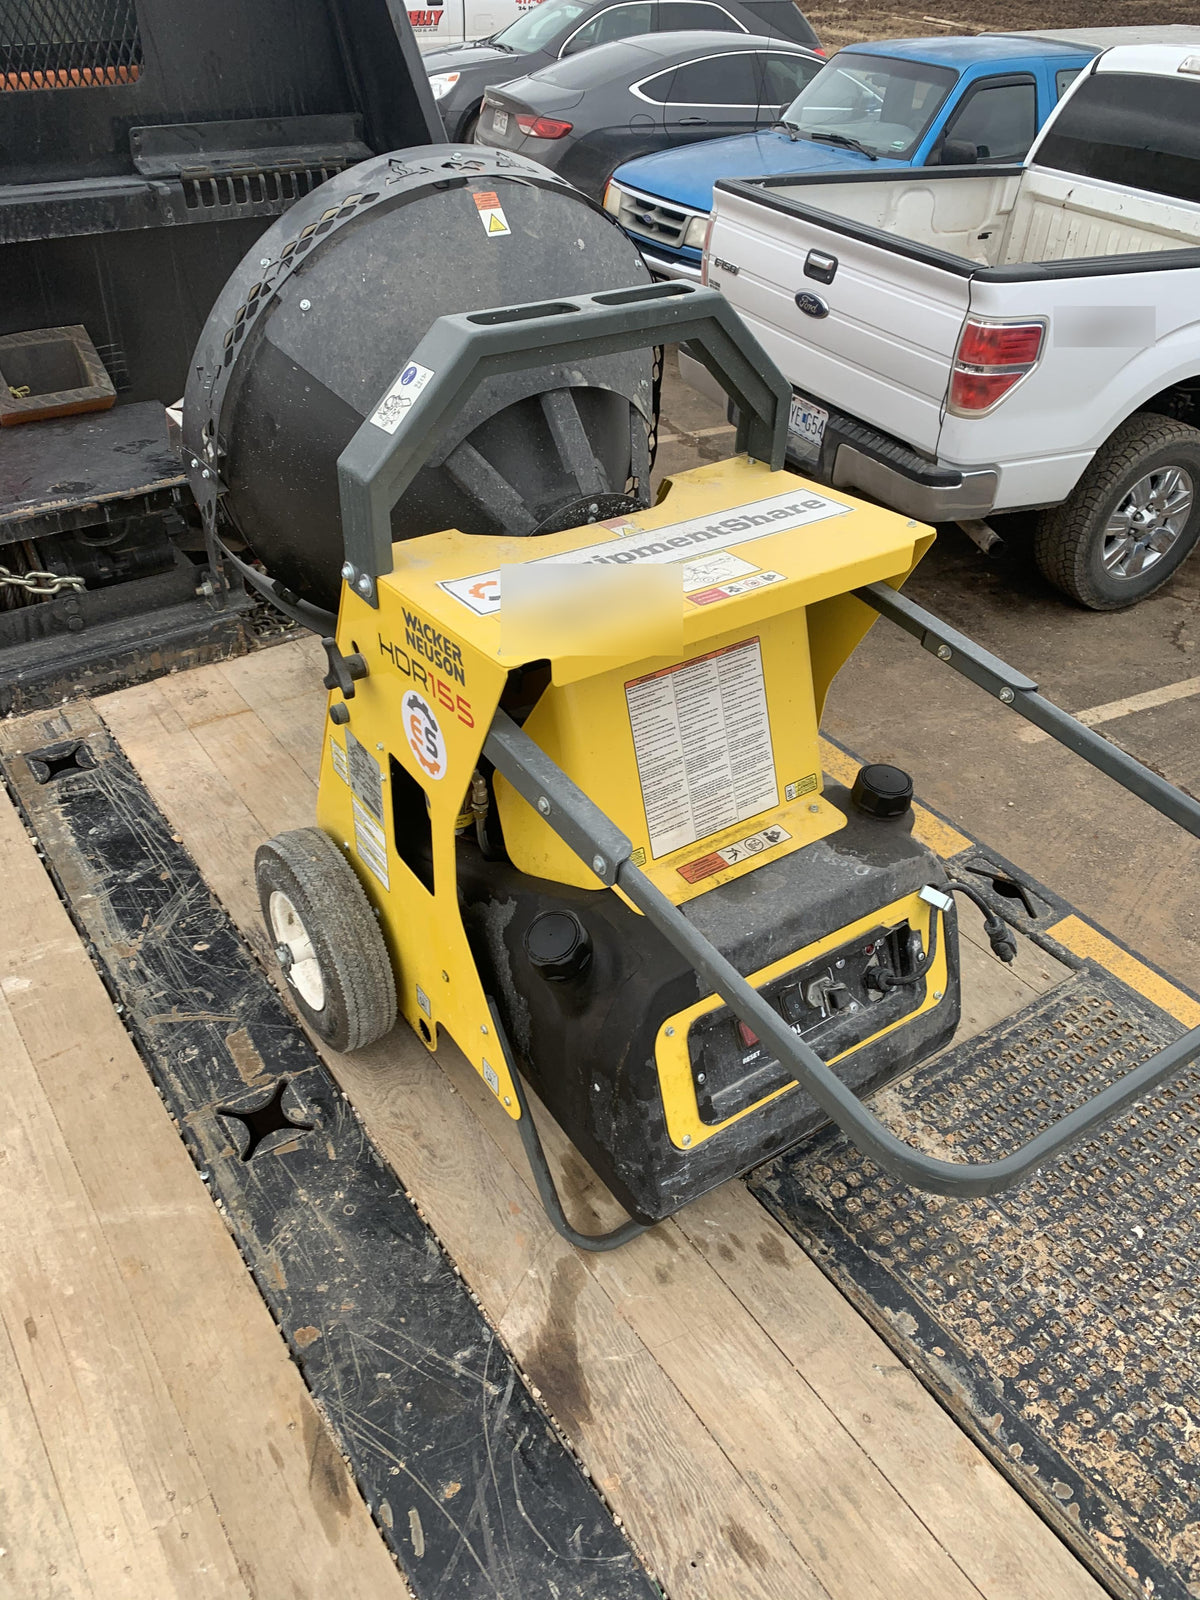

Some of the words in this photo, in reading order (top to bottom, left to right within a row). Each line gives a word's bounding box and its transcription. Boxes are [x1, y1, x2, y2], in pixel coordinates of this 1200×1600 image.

[583, 498, 827, 564] ipmentShare
[401, 606, 465, 667] WACKER
[405, 628, 466, 687] NEUSON
[378, 632, 475, 729] HDR155
[742, 1050, 761, 1064] RESET
